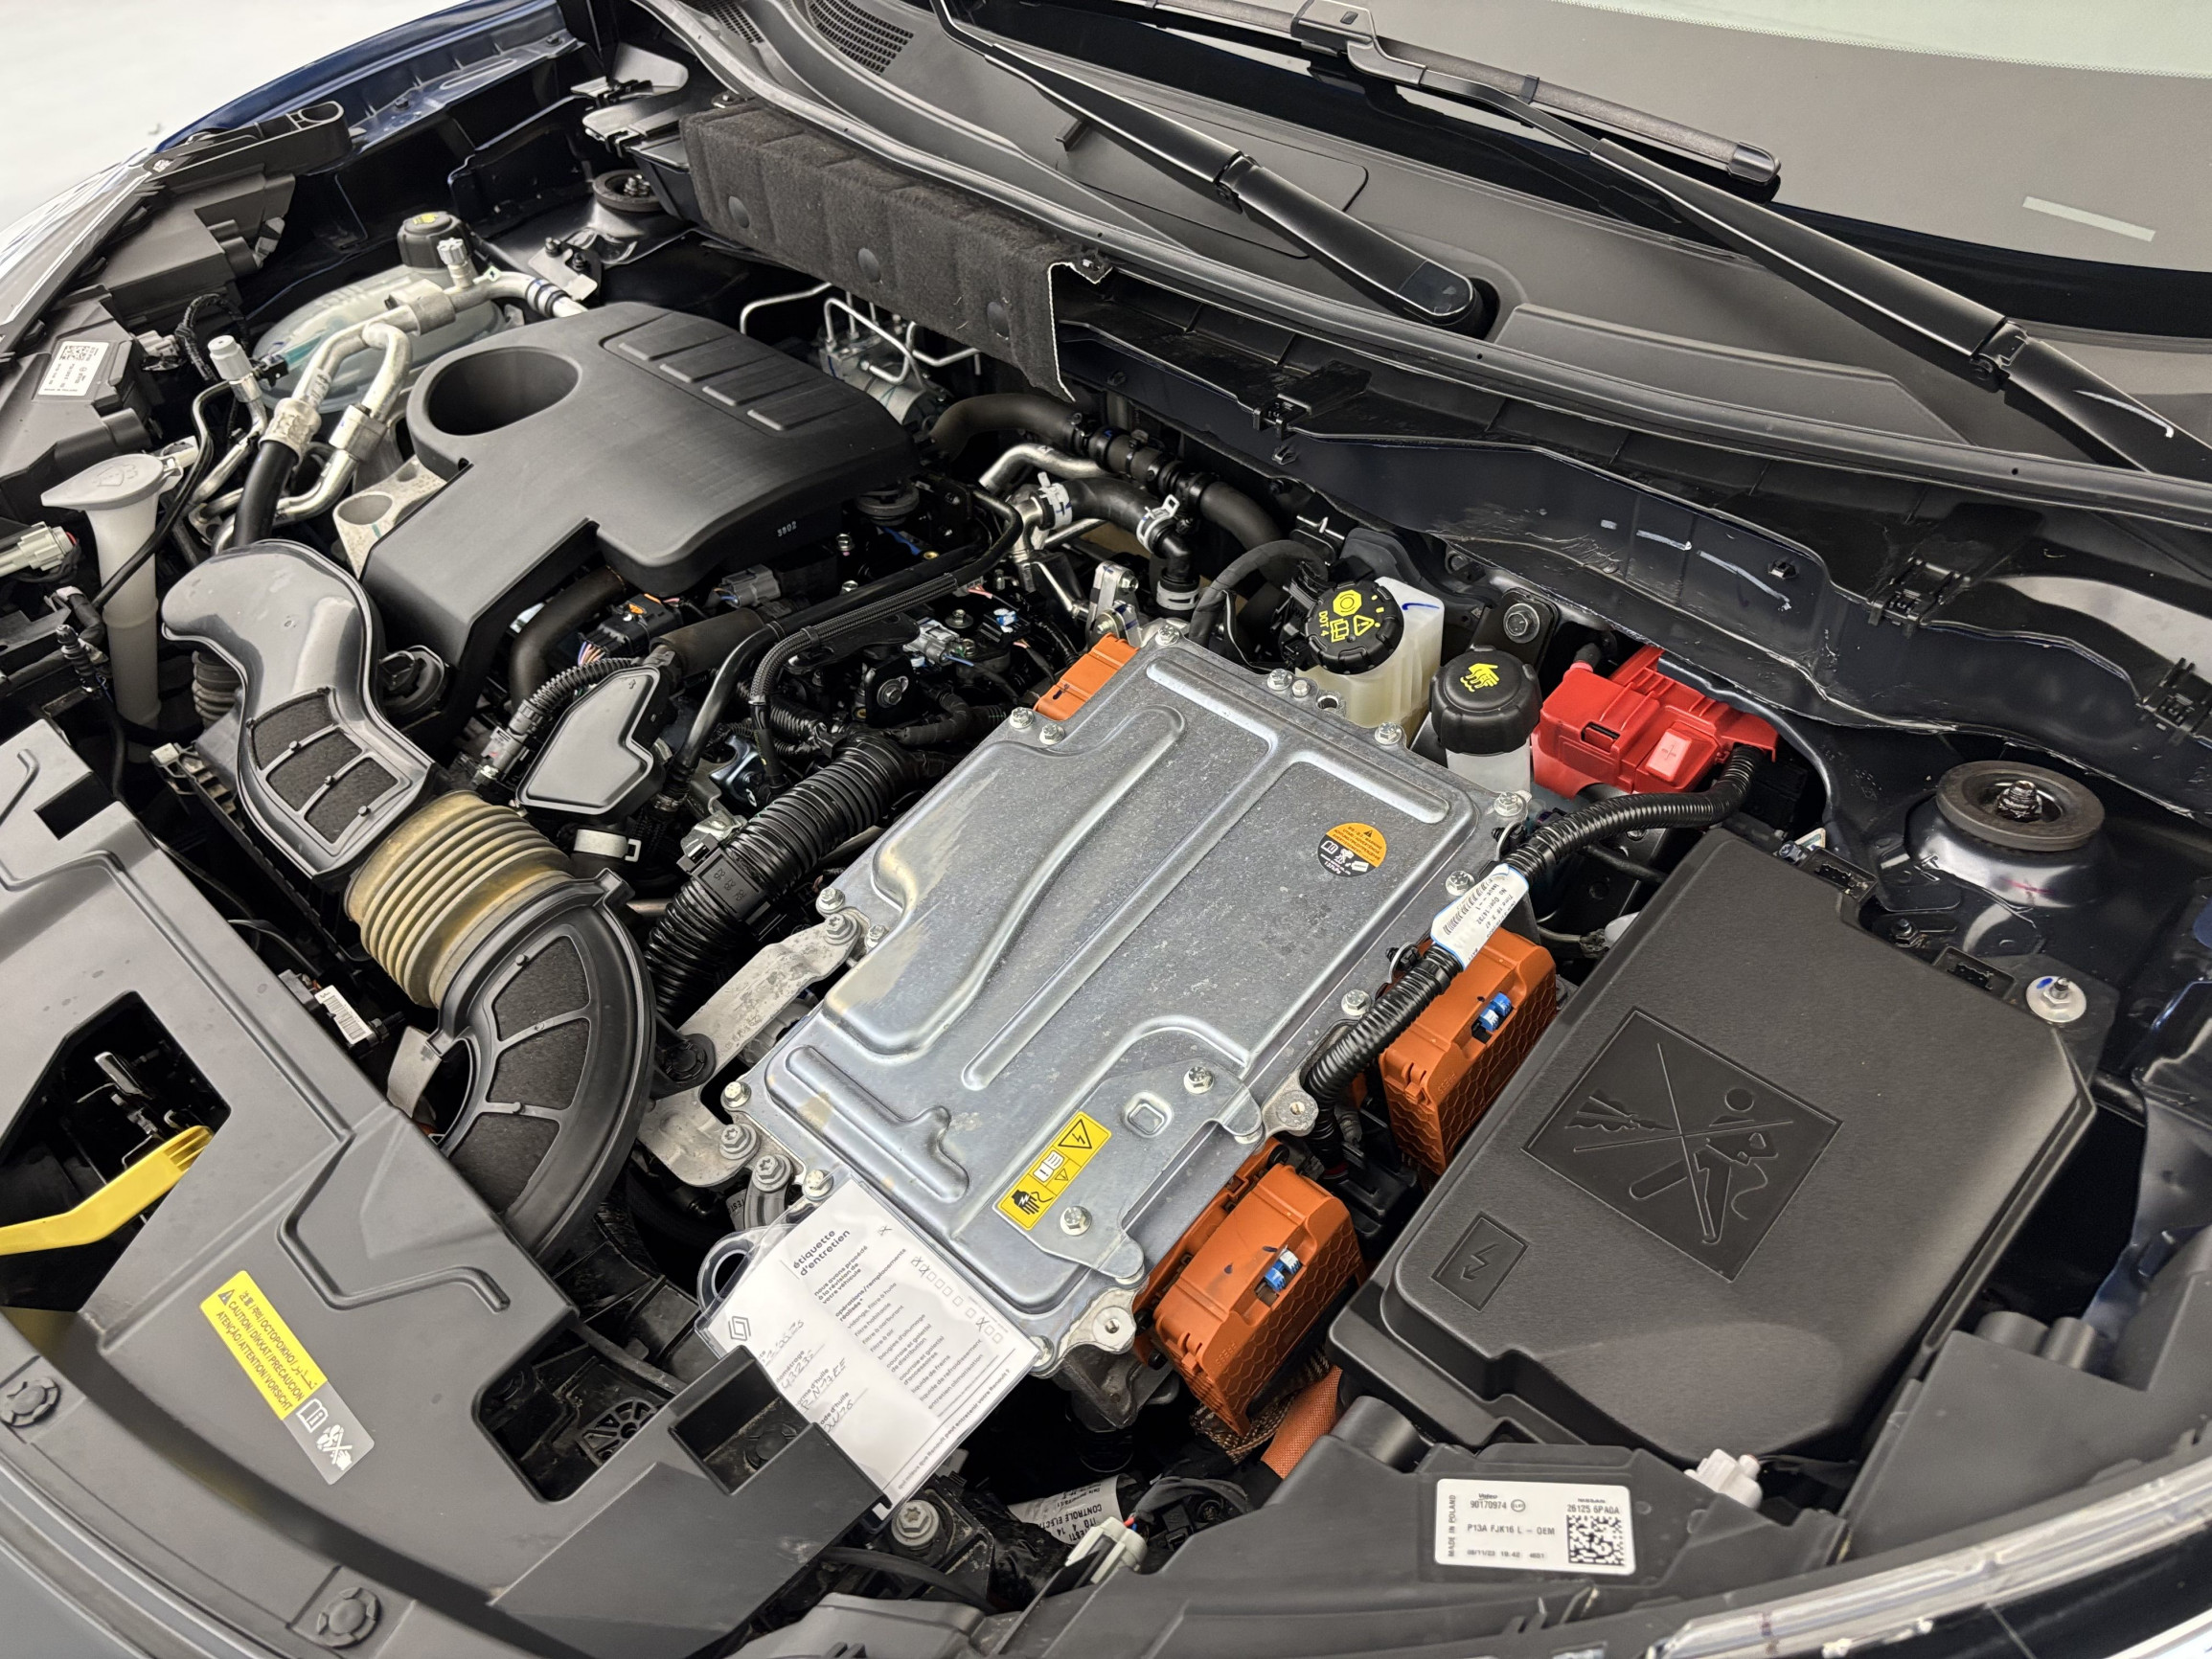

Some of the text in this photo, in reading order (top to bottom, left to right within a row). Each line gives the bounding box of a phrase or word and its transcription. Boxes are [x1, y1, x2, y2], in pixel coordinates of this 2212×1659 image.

[793, 1231, 835, 1269] étiquette
[814, 1245, 868, 1296] nous avons procédé
[822, 1268, 861, 1304] votre véhicule
[829, 1270, 852, 1291] révision
[1065, 1504, 1102, 1522] CONTROLE
[1470, 1499, 1506, 1510] 90170974
[1566, 1504, 1590, 1512] 26125
[1467, 1523, 1487, 1532] P13A
